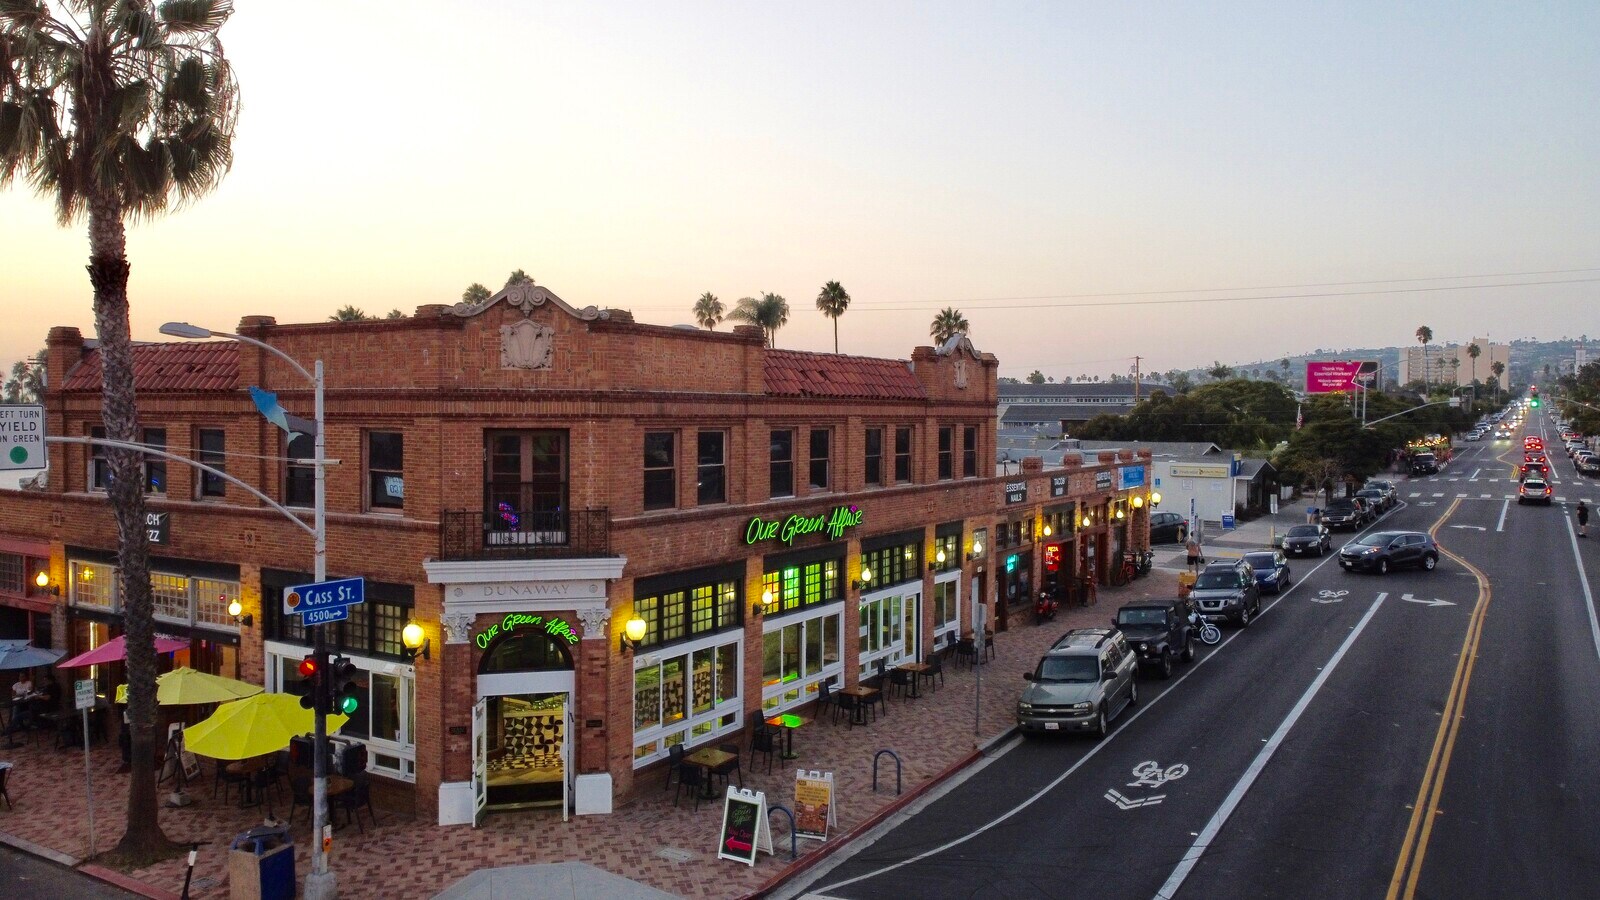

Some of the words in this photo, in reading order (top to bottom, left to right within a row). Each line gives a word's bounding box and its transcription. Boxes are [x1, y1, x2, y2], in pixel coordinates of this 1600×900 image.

[0, 422, 37, 431] YIELD
[1006, 481, 1026, 492] ESSENTIAL
[1010, 493, 1022, 502] NAILS
[146, 513, 160, 525] CH
[147, 530, 160, 542] ZZ
[484, 584, 570, 597] DUNAWAY
[308, 610, 330, 622] 4500
[76, 682, 82, 690] 2
